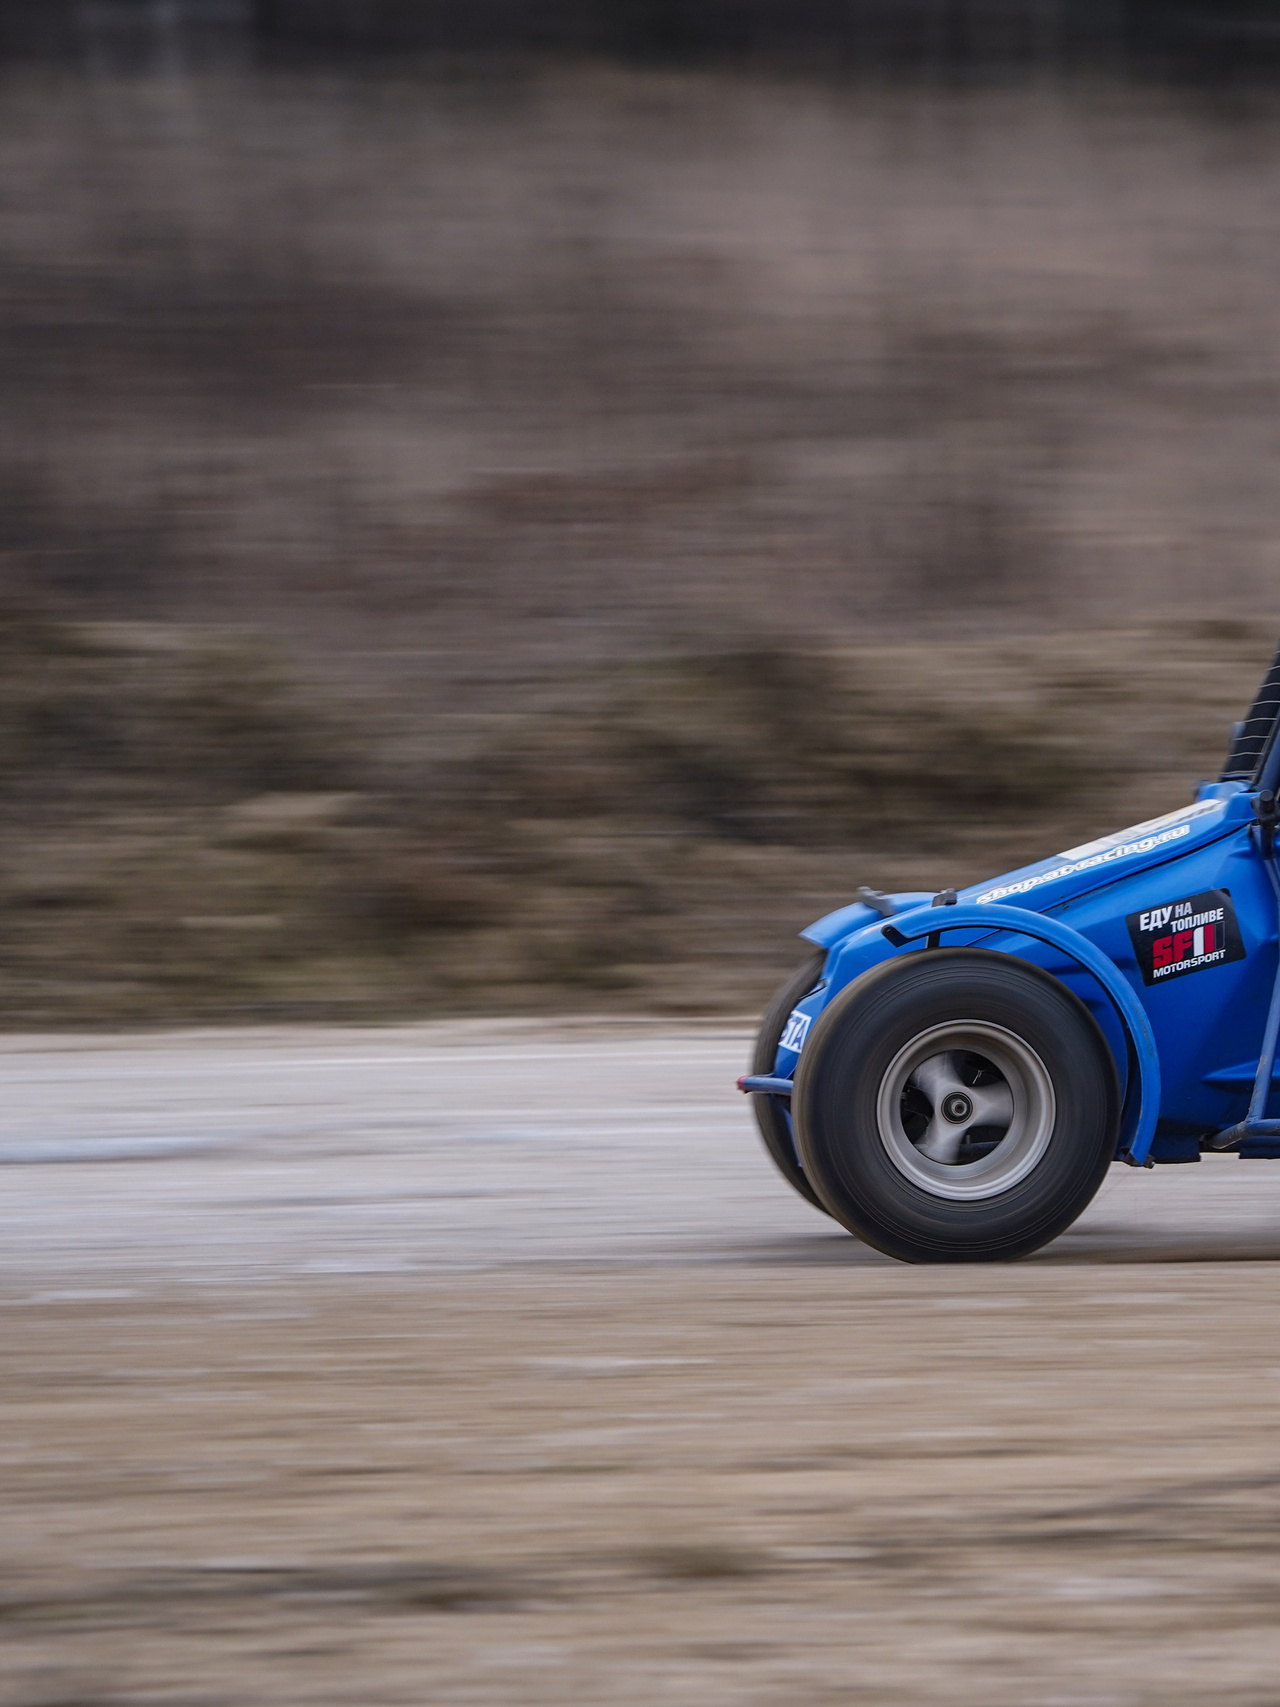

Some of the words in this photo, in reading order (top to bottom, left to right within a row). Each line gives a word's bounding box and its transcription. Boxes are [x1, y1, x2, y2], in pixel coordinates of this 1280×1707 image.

[1140, 905, 1173, 931] ЕДУ
[1174, 902, 1193, 918] НА
[1170, 908, 1224, 933] ТОПЛИВЕ
[1153, 949, 1226, 978] MOTORSPORT
